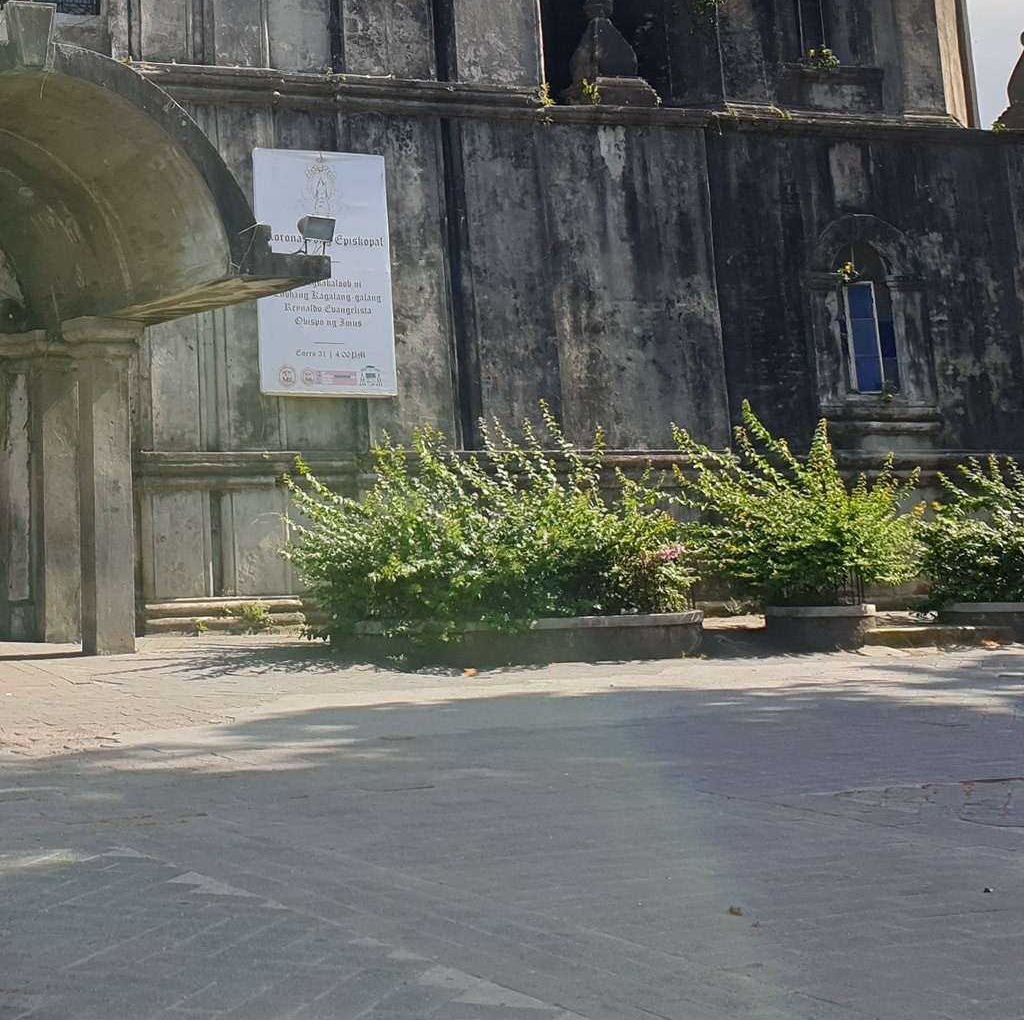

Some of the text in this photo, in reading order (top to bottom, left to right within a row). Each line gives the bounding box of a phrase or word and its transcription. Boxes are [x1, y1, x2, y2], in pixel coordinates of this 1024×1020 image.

[335, 235, 384, 247] Episkopal
[312, 291, 381, 303] Kagalang-galang
[284, 303, 372, 315] Reynaldo Evangelista
[295, 316, 362, 328] Obispo ng Imus
[296, 349, 316, 357] Enero
[335, 351, 366, 359] 4:00PM
